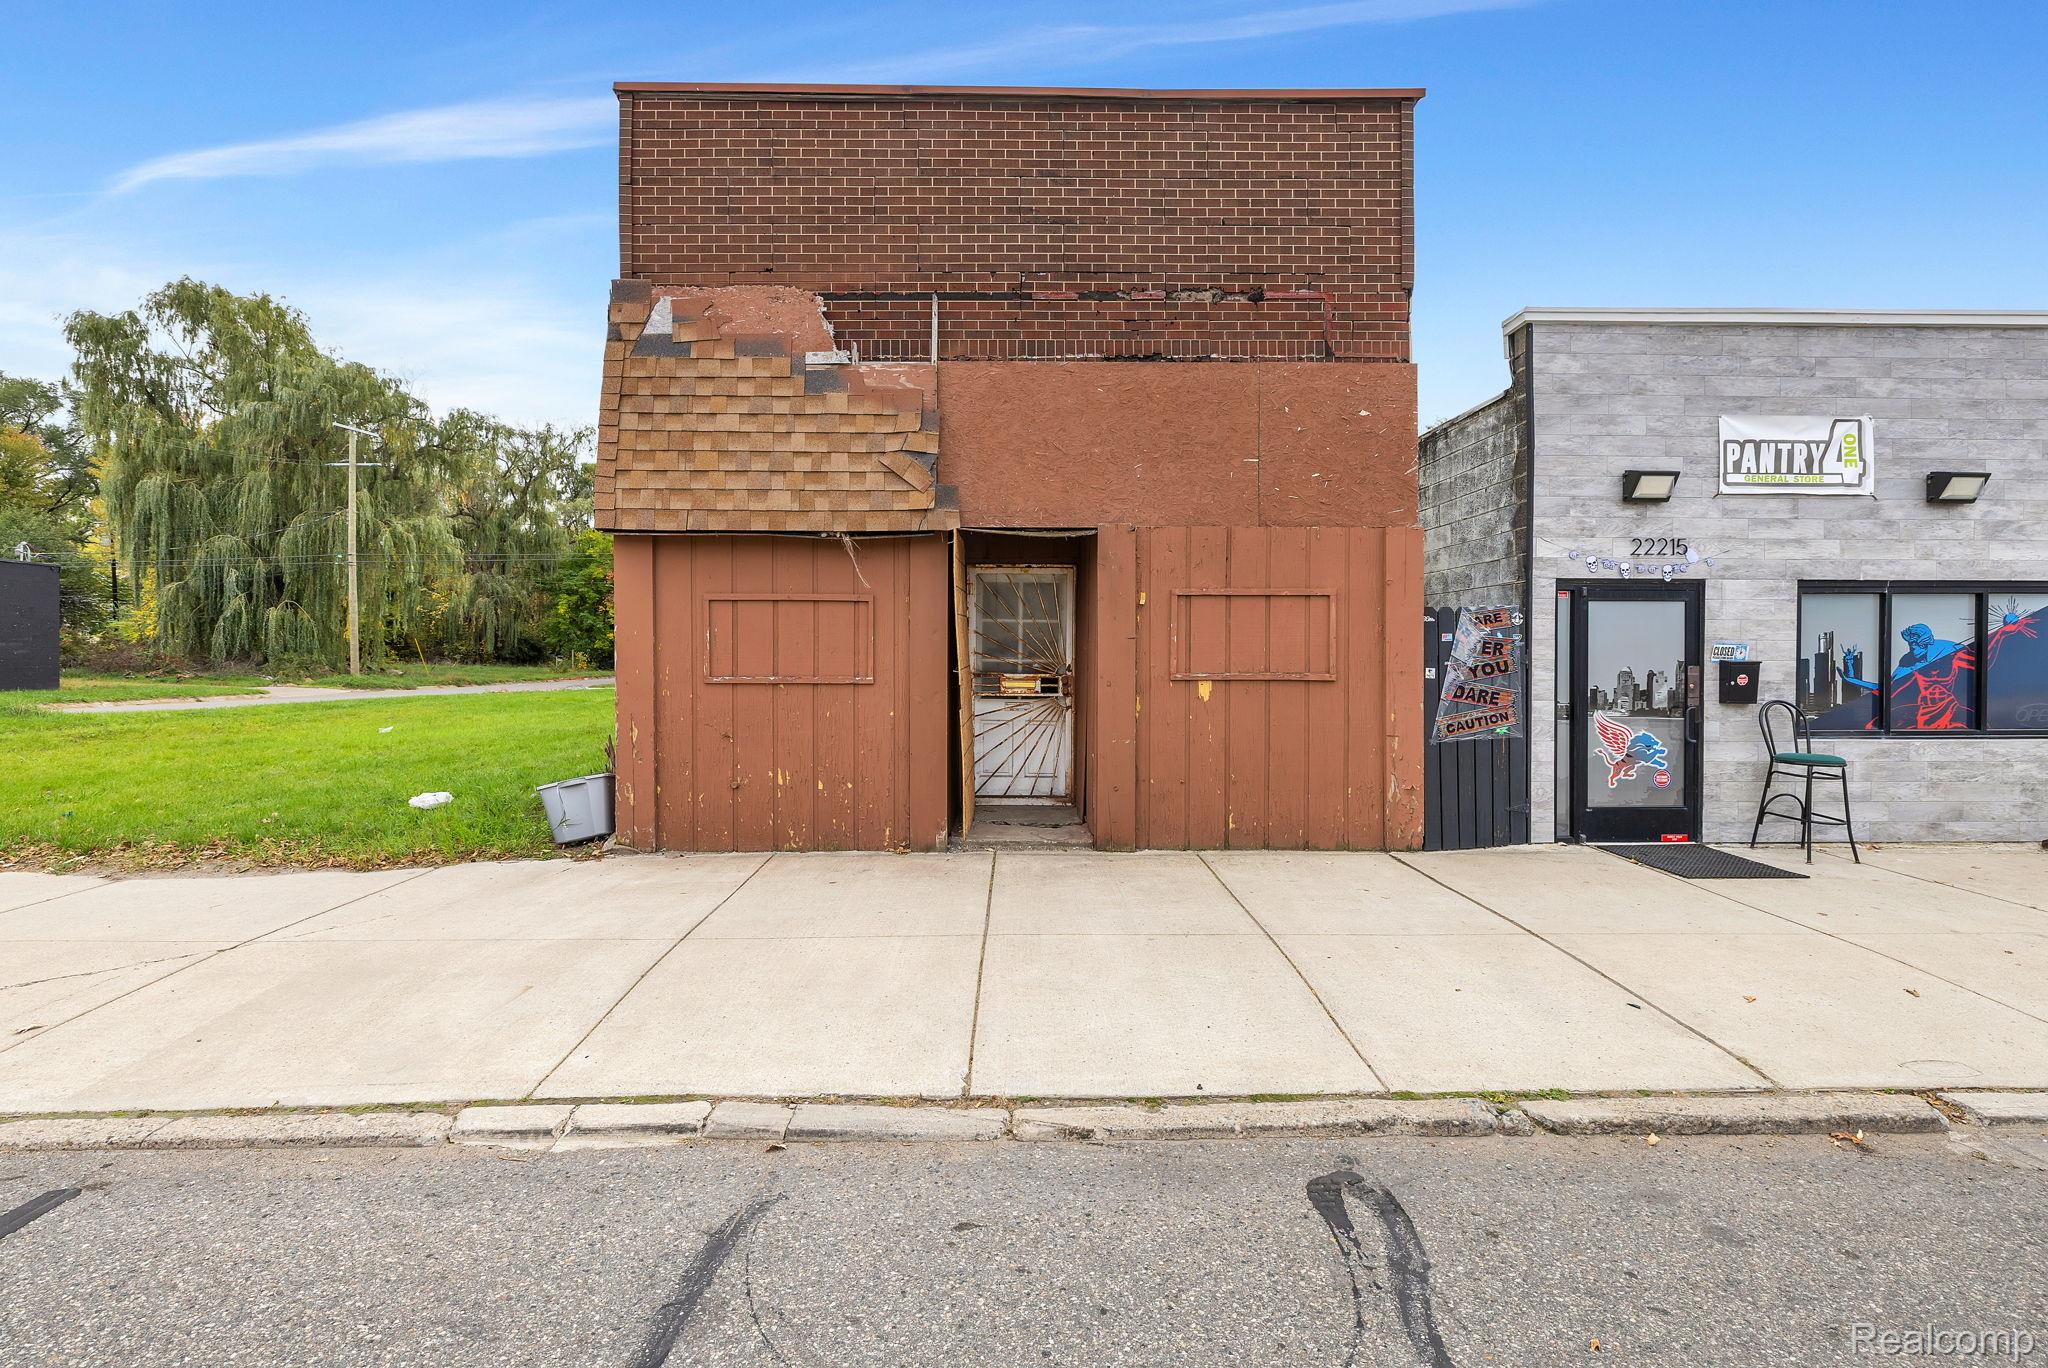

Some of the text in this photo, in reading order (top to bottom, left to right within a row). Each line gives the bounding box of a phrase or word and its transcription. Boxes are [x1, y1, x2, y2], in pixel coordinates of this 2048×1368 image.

[1726, 442, 1826, 474] PANTRY
[1843, 433, 1858, 468] ONE
[1744, 475, 1825, 483] GENERAL STORE
[1630, 537, 1689, 556] 22215
[1712, 646, 1735, 657] CLOSED
[1469, 660, 1509, 679] YOU
[1452, 685, 1501, 707] DARE
[1446, 711, 1510, 734] CAUTION
